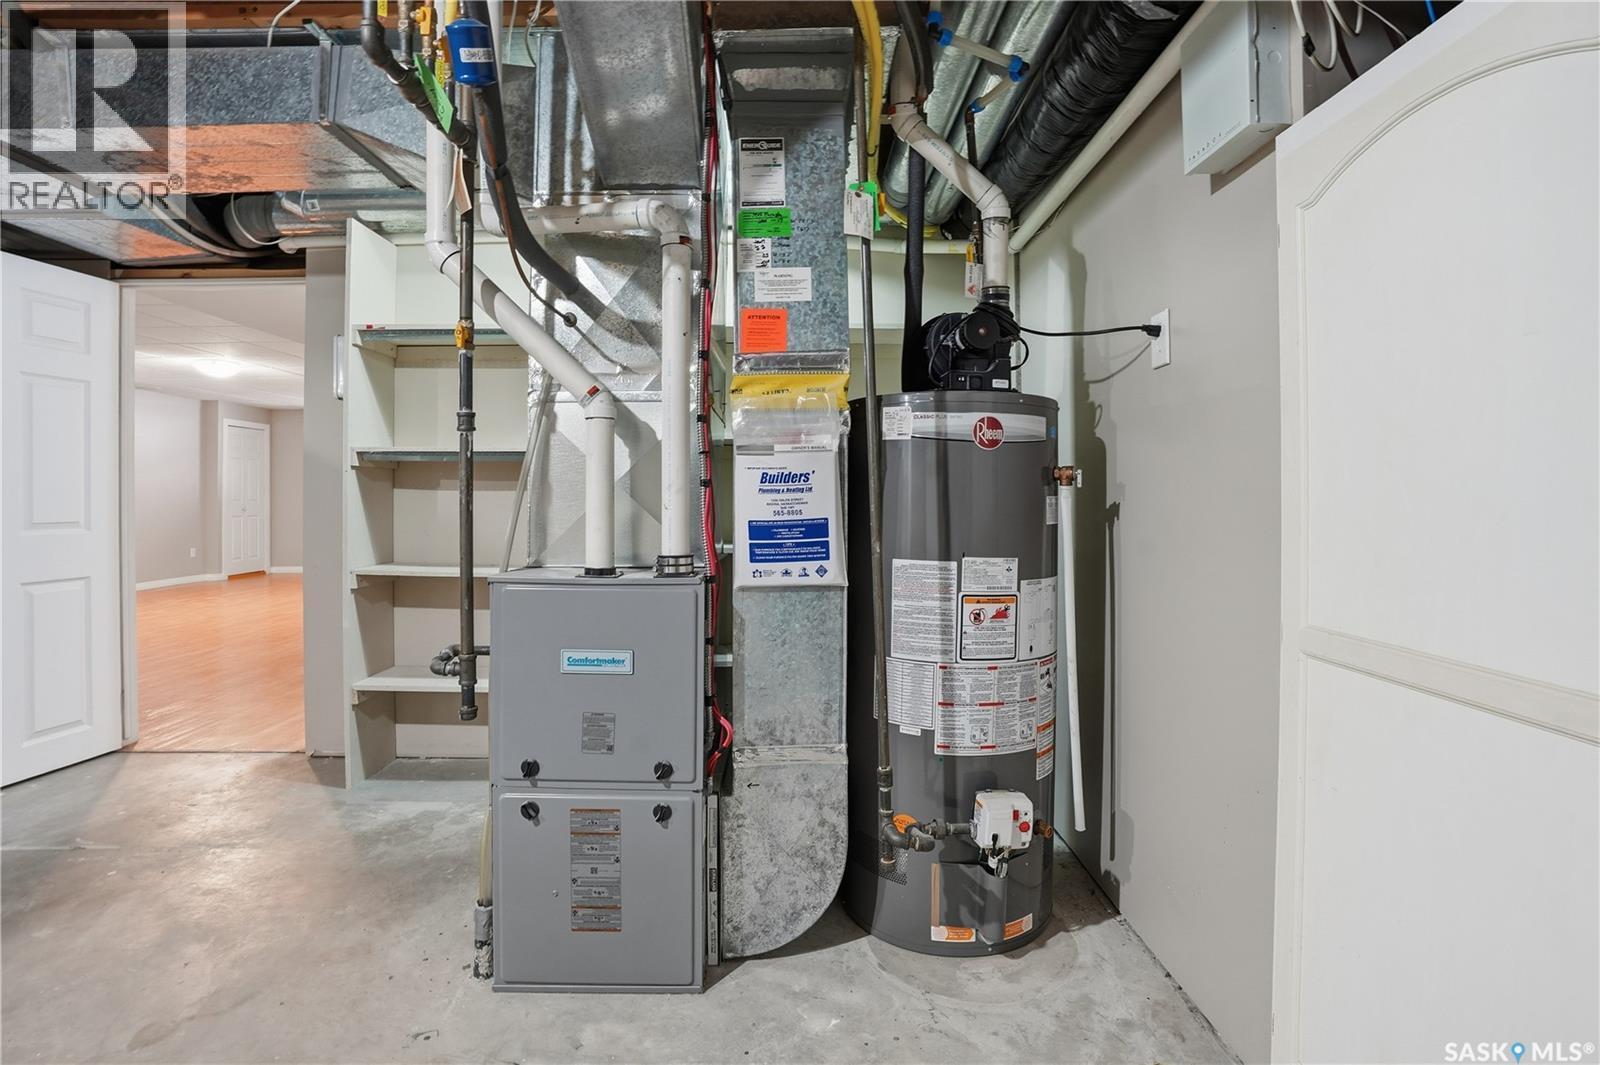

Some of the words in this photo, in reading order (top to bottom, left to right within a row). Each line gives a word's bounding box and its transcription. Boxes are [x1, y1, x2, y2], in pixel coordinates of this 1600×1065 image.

[977, 416, 1003, 444] Rheem
[760, 470, 816, 484] Builders'
[758, 487, 781, 495] Plumbing
[786, 486, 804, 494] Heating
[567, 656, 626, 665] Comfortmaker
